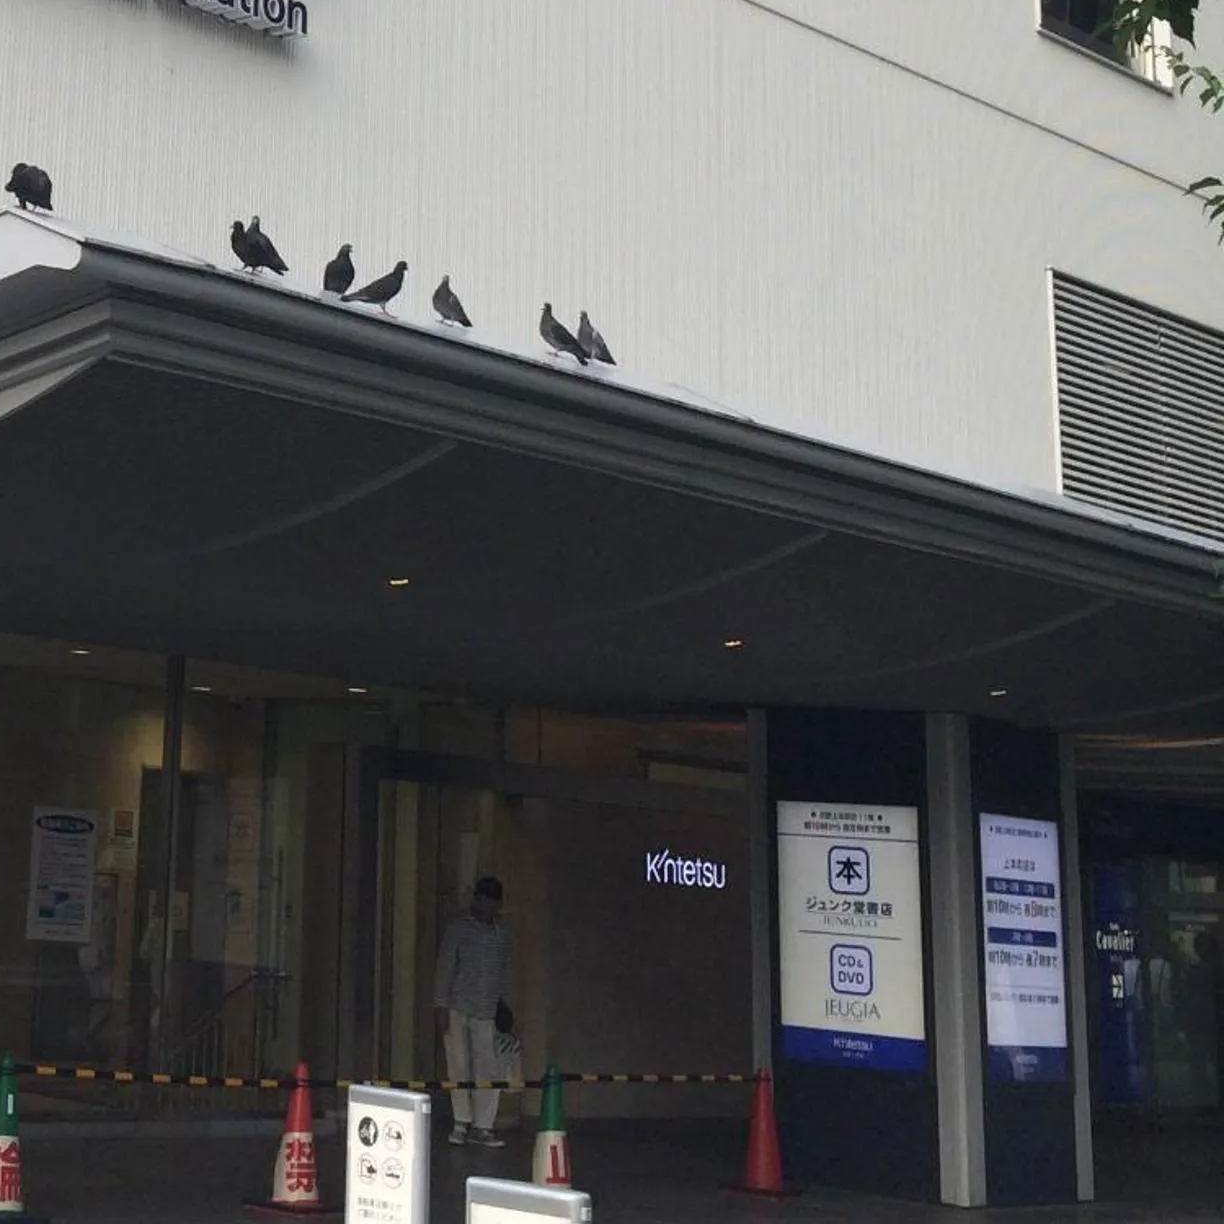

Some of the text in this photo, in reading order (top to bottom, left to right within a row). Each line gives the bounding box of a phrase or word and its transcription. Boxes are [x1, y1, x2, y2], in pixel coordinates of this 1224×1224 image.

[836, 856, 863, 886] 本
[806, 896, 893, 917] ジュンク堂書店
[838, 971, 865, 985] DVD
